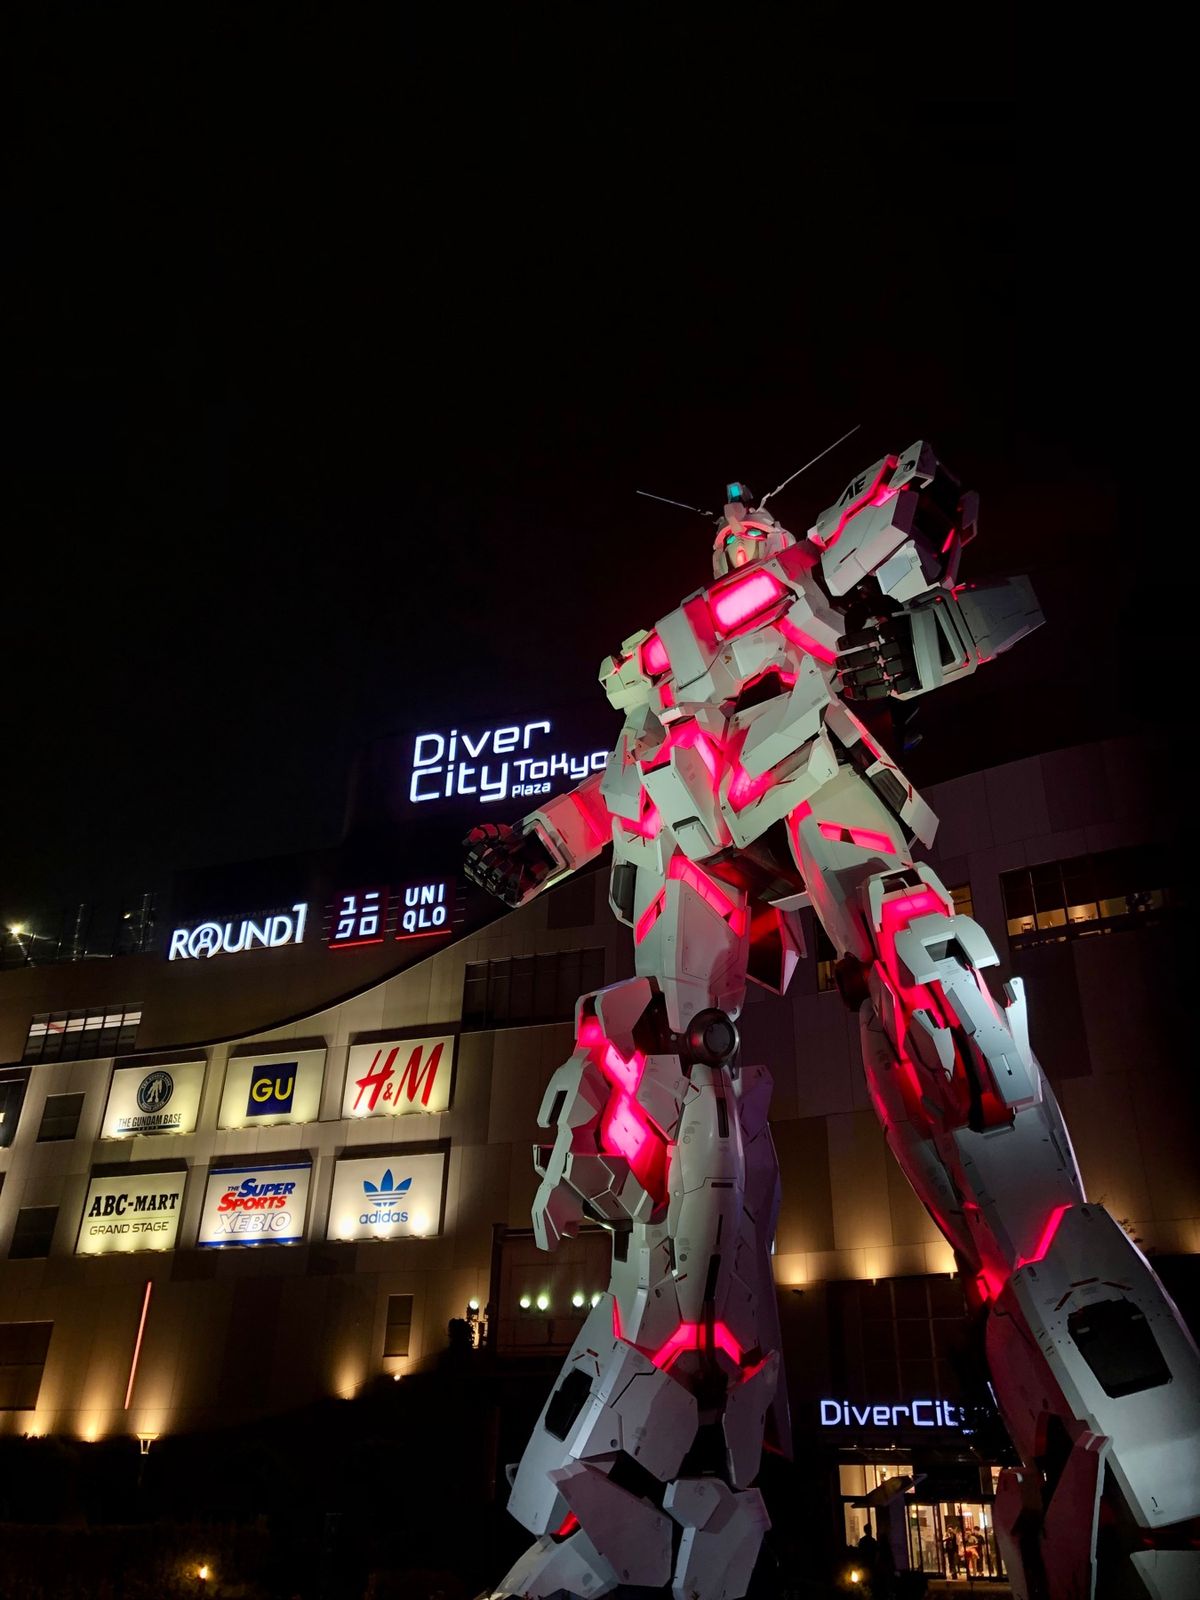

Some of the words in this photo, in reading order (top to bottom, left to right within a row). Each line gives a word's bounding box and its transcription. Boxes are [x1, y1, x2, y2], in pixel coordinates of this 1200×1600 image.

[413, 721, 551, 768] Diver
[409, 762, 508, 803] City
[511, 782, 551, 798] Plaza
[405, 883, 445, 907] UNI
[402, 905, 446, 933] QLO
[168, 903, 308, 961] ROUND1
[353, 1042, 444, 1111] H&M
[252, 1076, 293, 1103] GU
[118, 1117, 132, 1128] THE
[131, 1114, 163, 1127] GUNDAM
[163, 1113, 182, 1125] BASE
[237, 1178, 296, 1197] SUPER
[88, 1193, 179, 1218] ABC-MART
[217, 1192, 287, 1212] SPORTS
[89, 1223, 130, 1236] GRAND
[132, 1221, 170, 1233] STAGE
[213, 1211, 291, 1234] XEBIO
[359, 1210, 409, 1225] adidas
